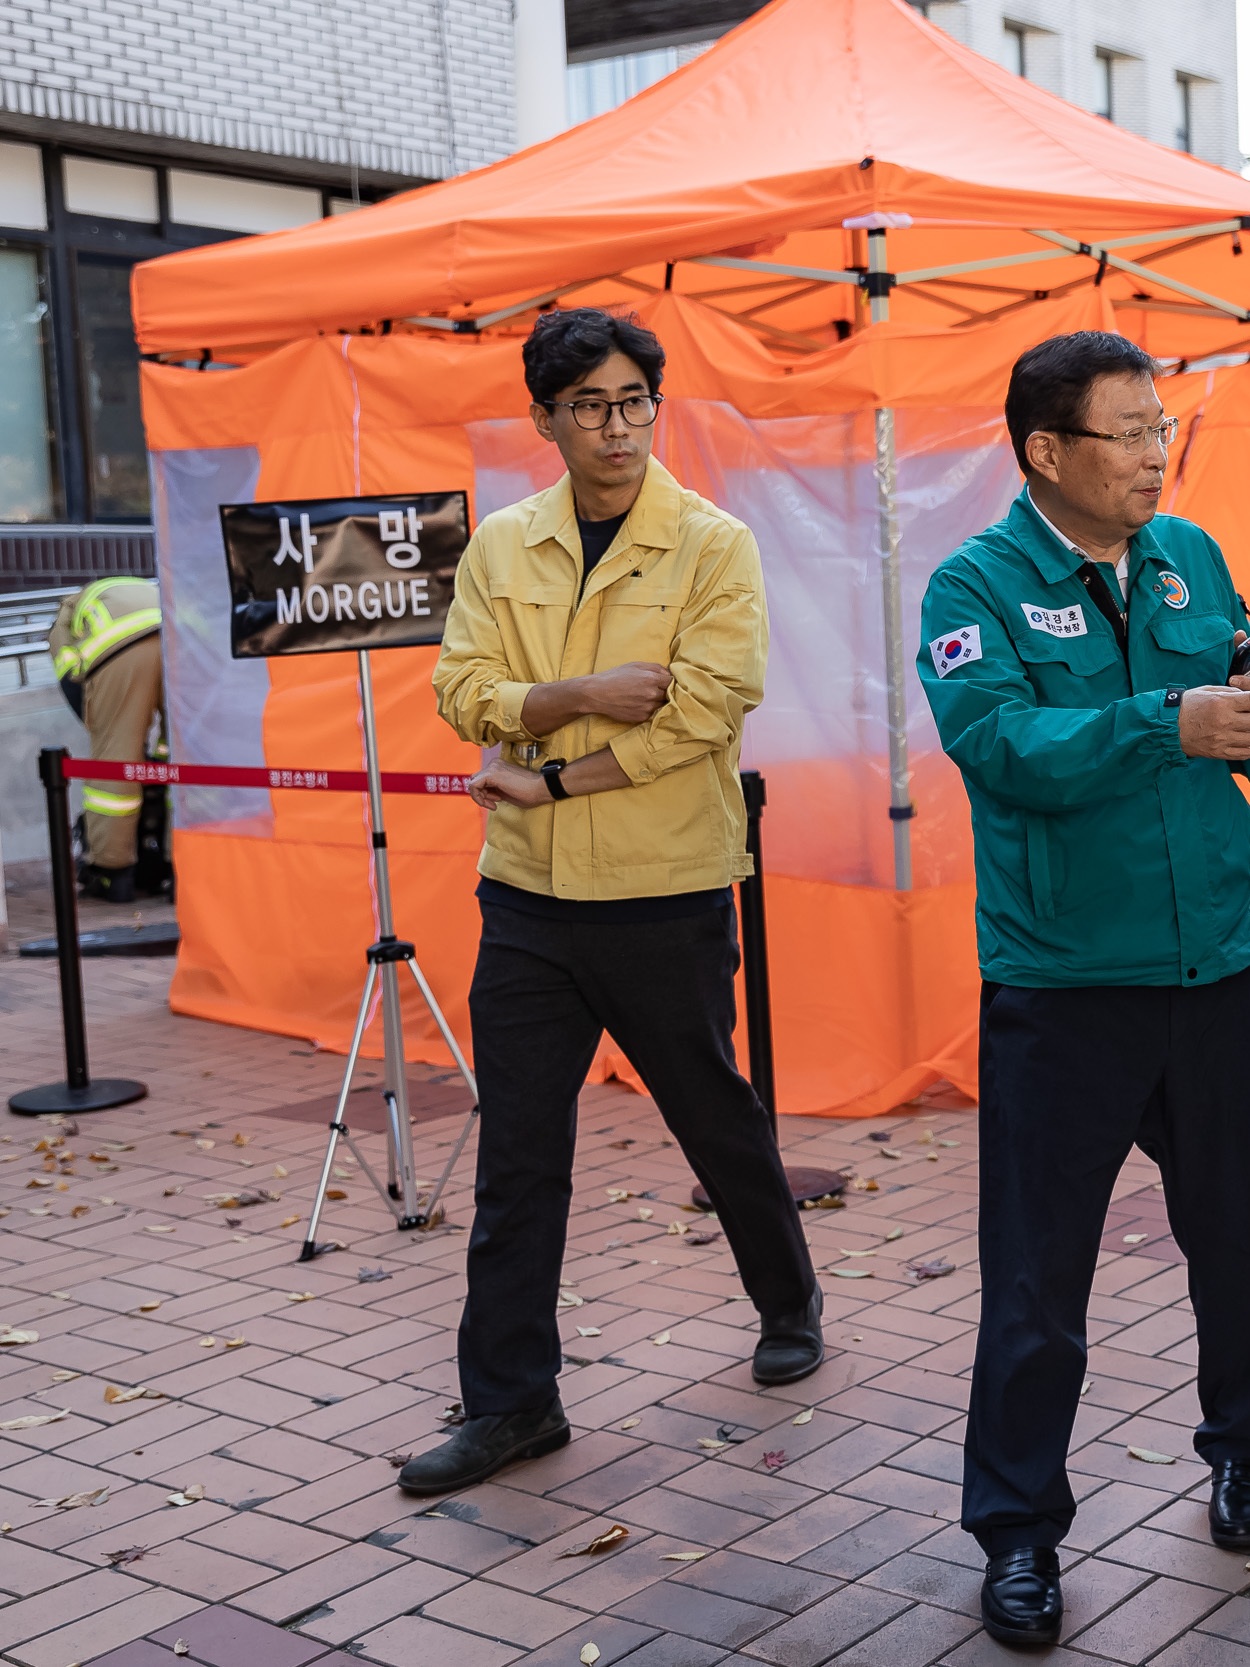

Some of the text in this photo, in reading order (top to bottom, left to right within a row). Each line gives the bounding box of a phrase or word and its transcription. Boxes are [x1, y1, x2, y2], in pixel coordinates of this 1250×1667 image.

[276, 579, 430, 624] MORGUE
[123, 764, 179, 782] 광진소방서
[269, 770, 328, 788] 광진소방서
